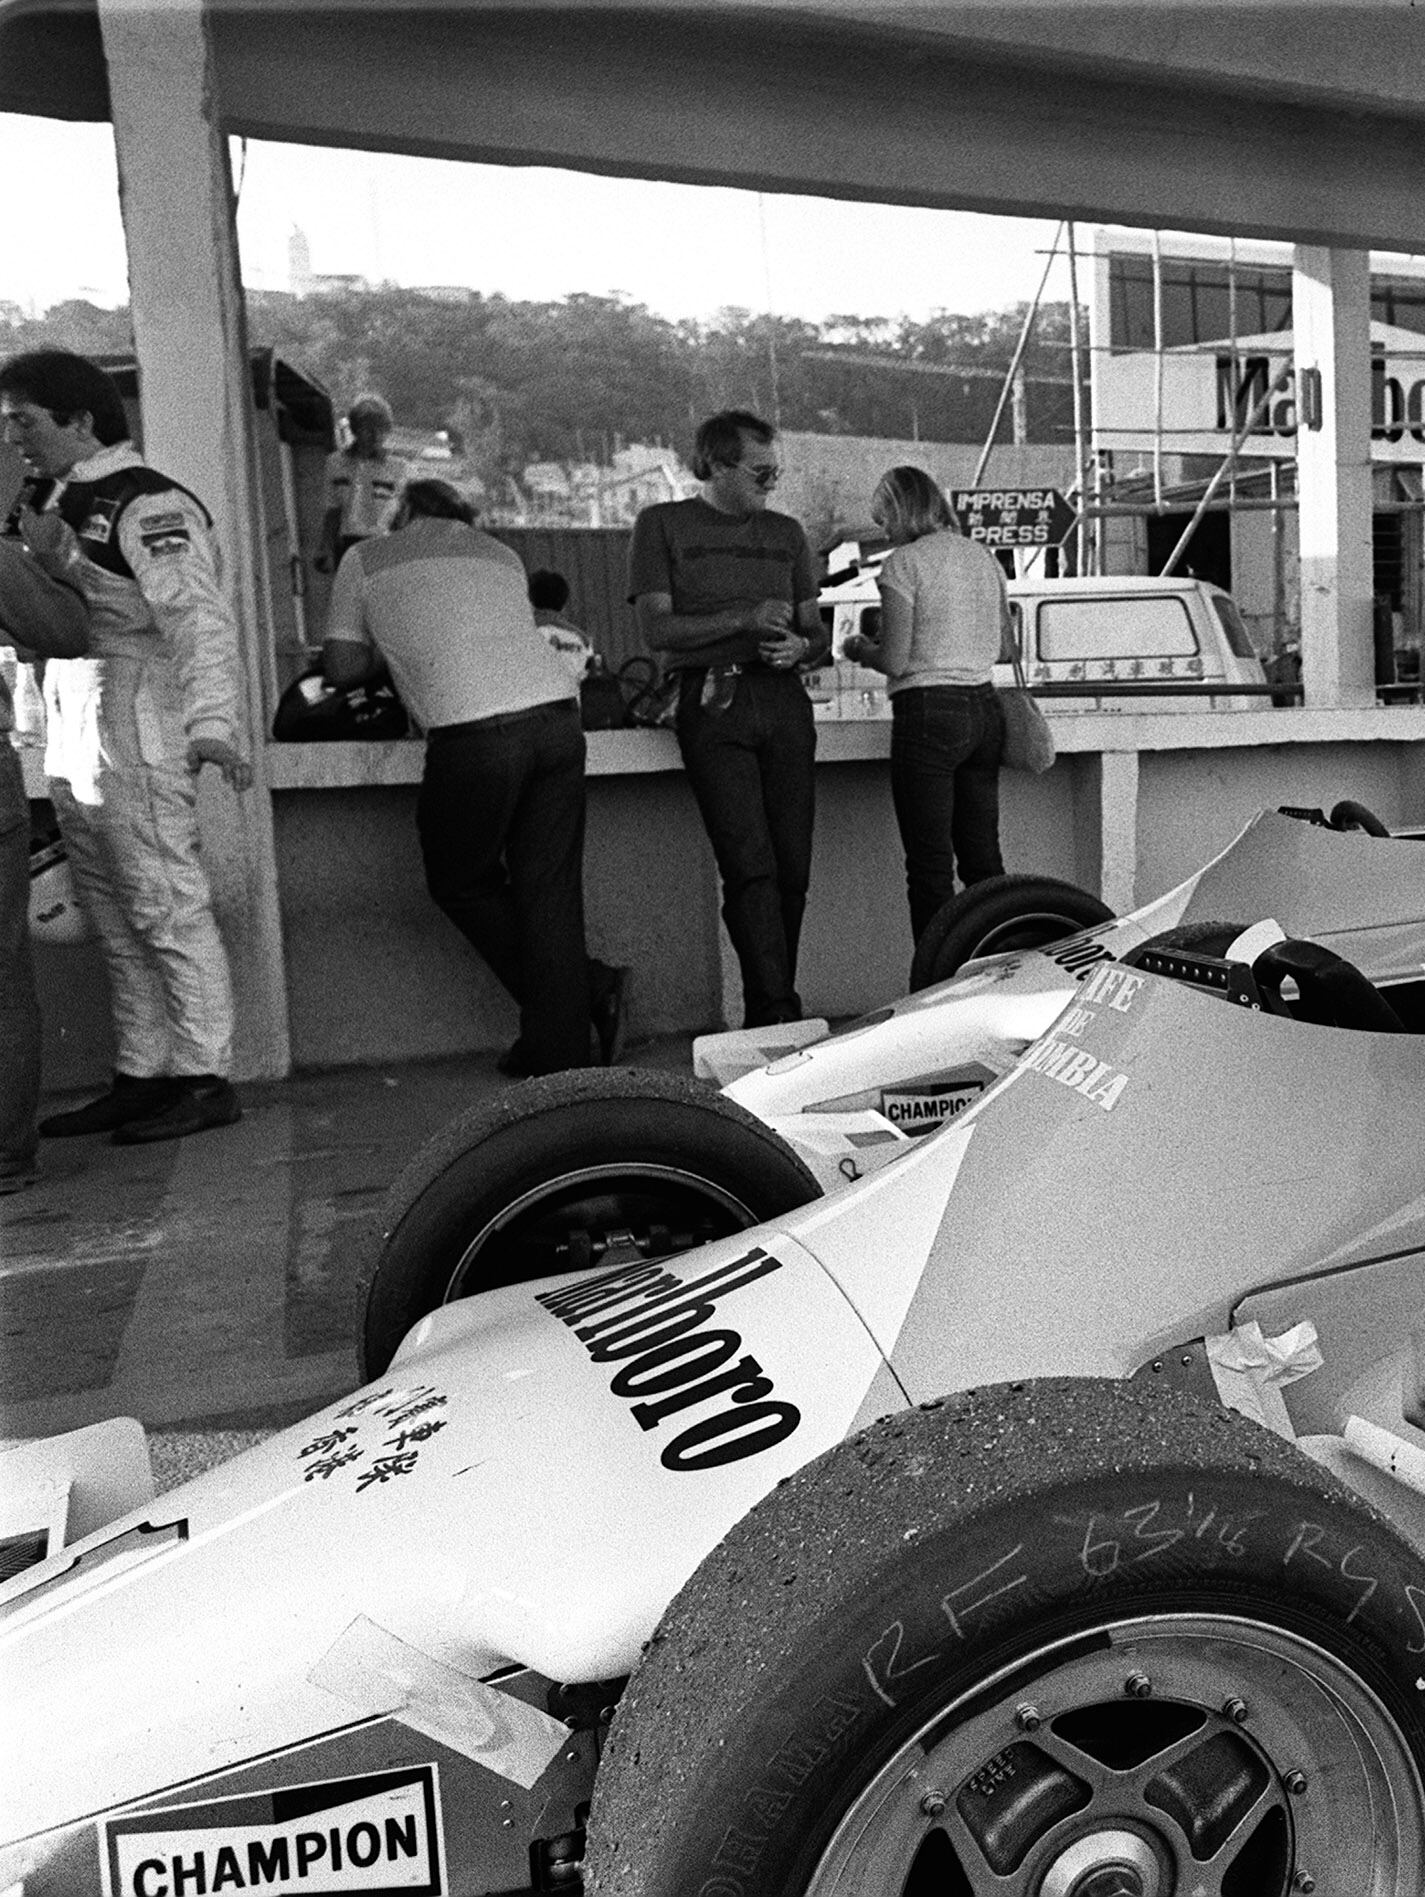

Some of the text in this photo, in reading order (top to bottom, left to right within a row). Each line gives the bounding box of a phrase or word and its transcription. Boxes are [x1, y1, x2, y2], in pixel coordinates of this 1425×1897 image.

[957, 491, 1055, 511] IMPRENSA
[970, 525, 1049, 544] PRESS
[888, 1097, 973, 1121] CHAMPIO
[533, 1246, 801, 1471] Marlboro
[132, 1814, 419, 1897] CHAMPION
